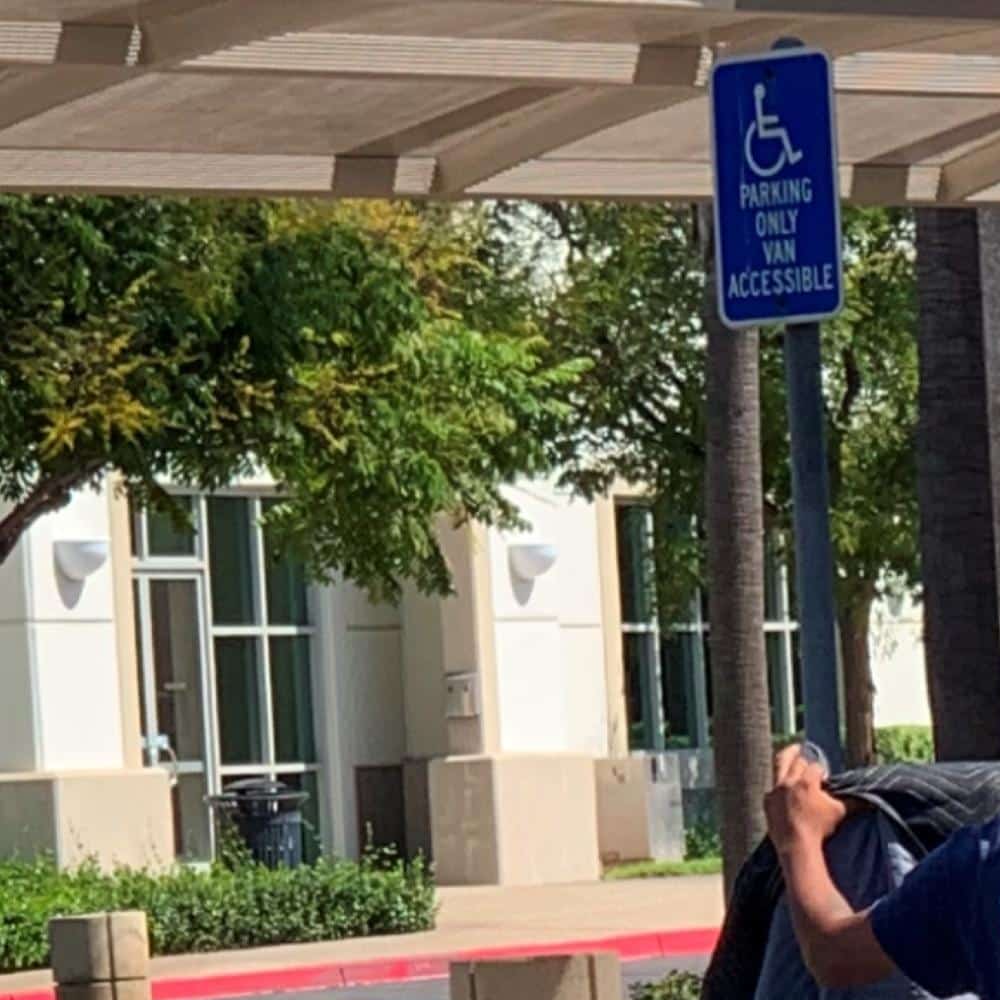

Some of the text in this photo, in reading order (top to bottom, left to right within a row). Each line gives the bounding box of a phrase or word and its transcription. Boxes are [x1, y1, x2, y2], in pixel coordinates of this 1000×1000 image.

[740, 178, 812, 208] PARKING
[756, 209, 798, 237] ONLY
[763, 239, 796, 264] VAN
[729, 263, 834, 299] ACCESSIBLE
